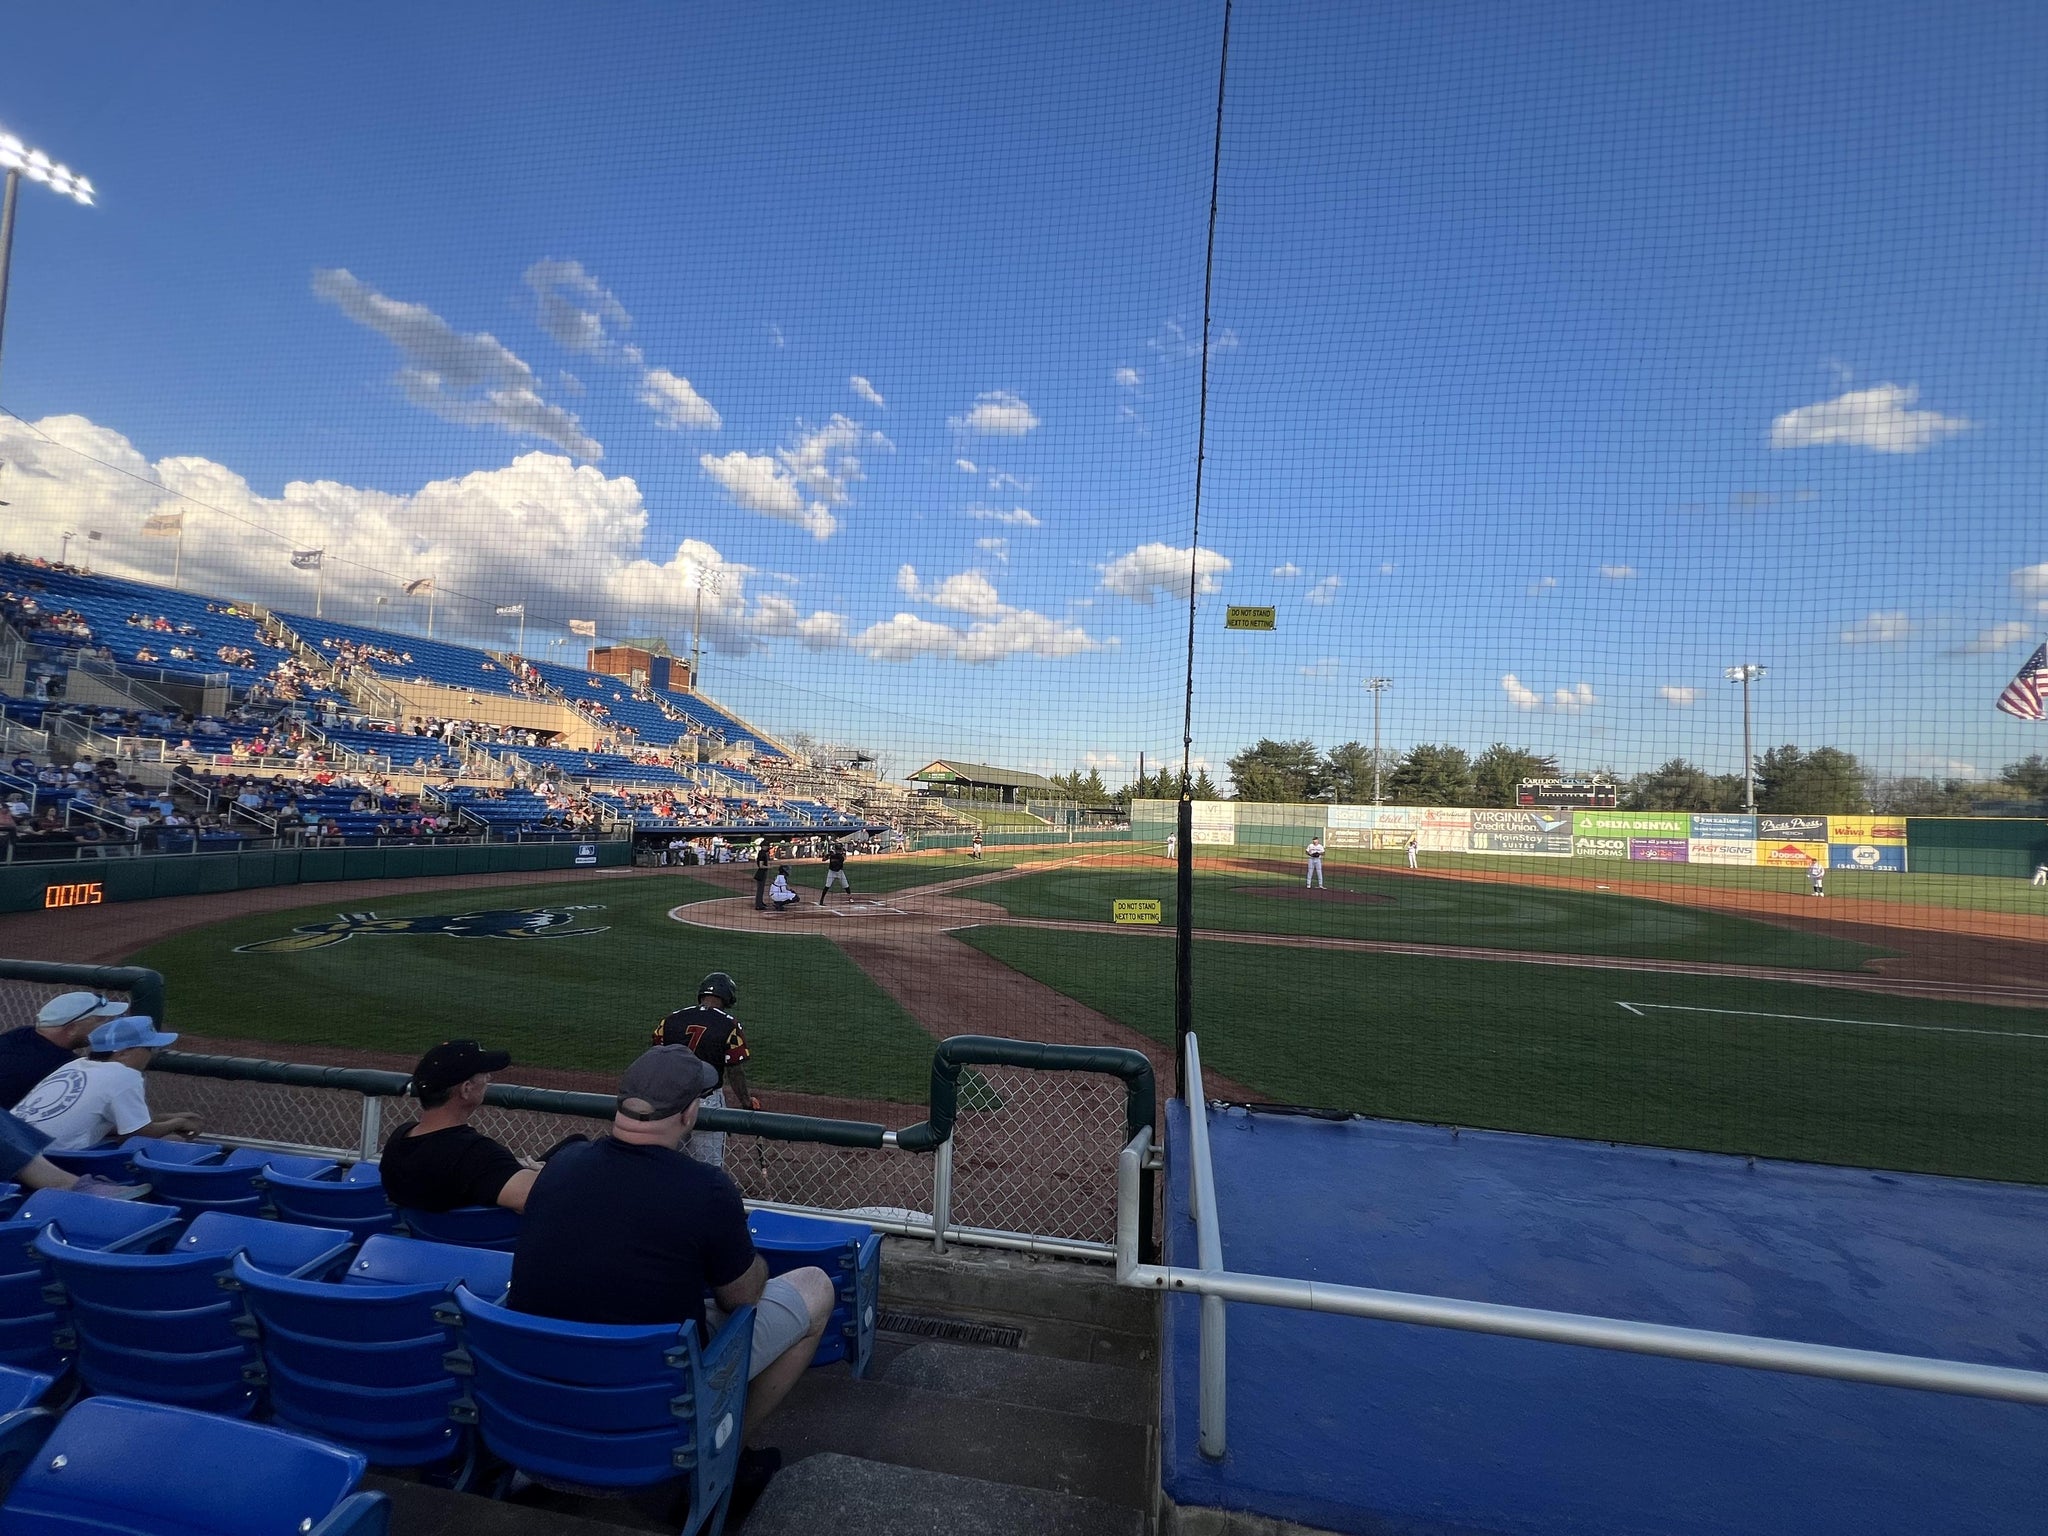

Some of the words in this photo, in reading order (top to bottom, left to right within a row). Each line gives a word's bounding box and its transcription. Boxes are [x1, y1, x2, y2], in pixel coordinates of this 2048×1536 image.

[1252, 609, 1271, 617] STAND
[1242, 619, 1250, 627] TO
[1250, 620, 1273, 628] NETTING
[1473, 811, 1531, 822] VIRGINIA
[1473, 821, 1505, 831] Credit
[1596, 820, 1631, 829] DELTA
[1632, 821, 1681, 831] DENTAL
[1834, 825, 1864, 836] Wawa
[1494, 833, 1543, 844] MainStay
[1575, 837, 1626, 849] ALSCO
[1576, 848, 1624, 857] UNIFORMS
[1857, 851, 1875, 859] ADT
[1117, 902, 1126, 910] DO
[1127, 902, 1138, 910] NOT
[1138, 902, 1156, 910] STAND
[1114, 912, 1129, 920] NEXT
[1129, 912, 1137, 920] TO
[1137, 912, 1160, 921] NETTING
[685, 1024, 708, 1054] 7
